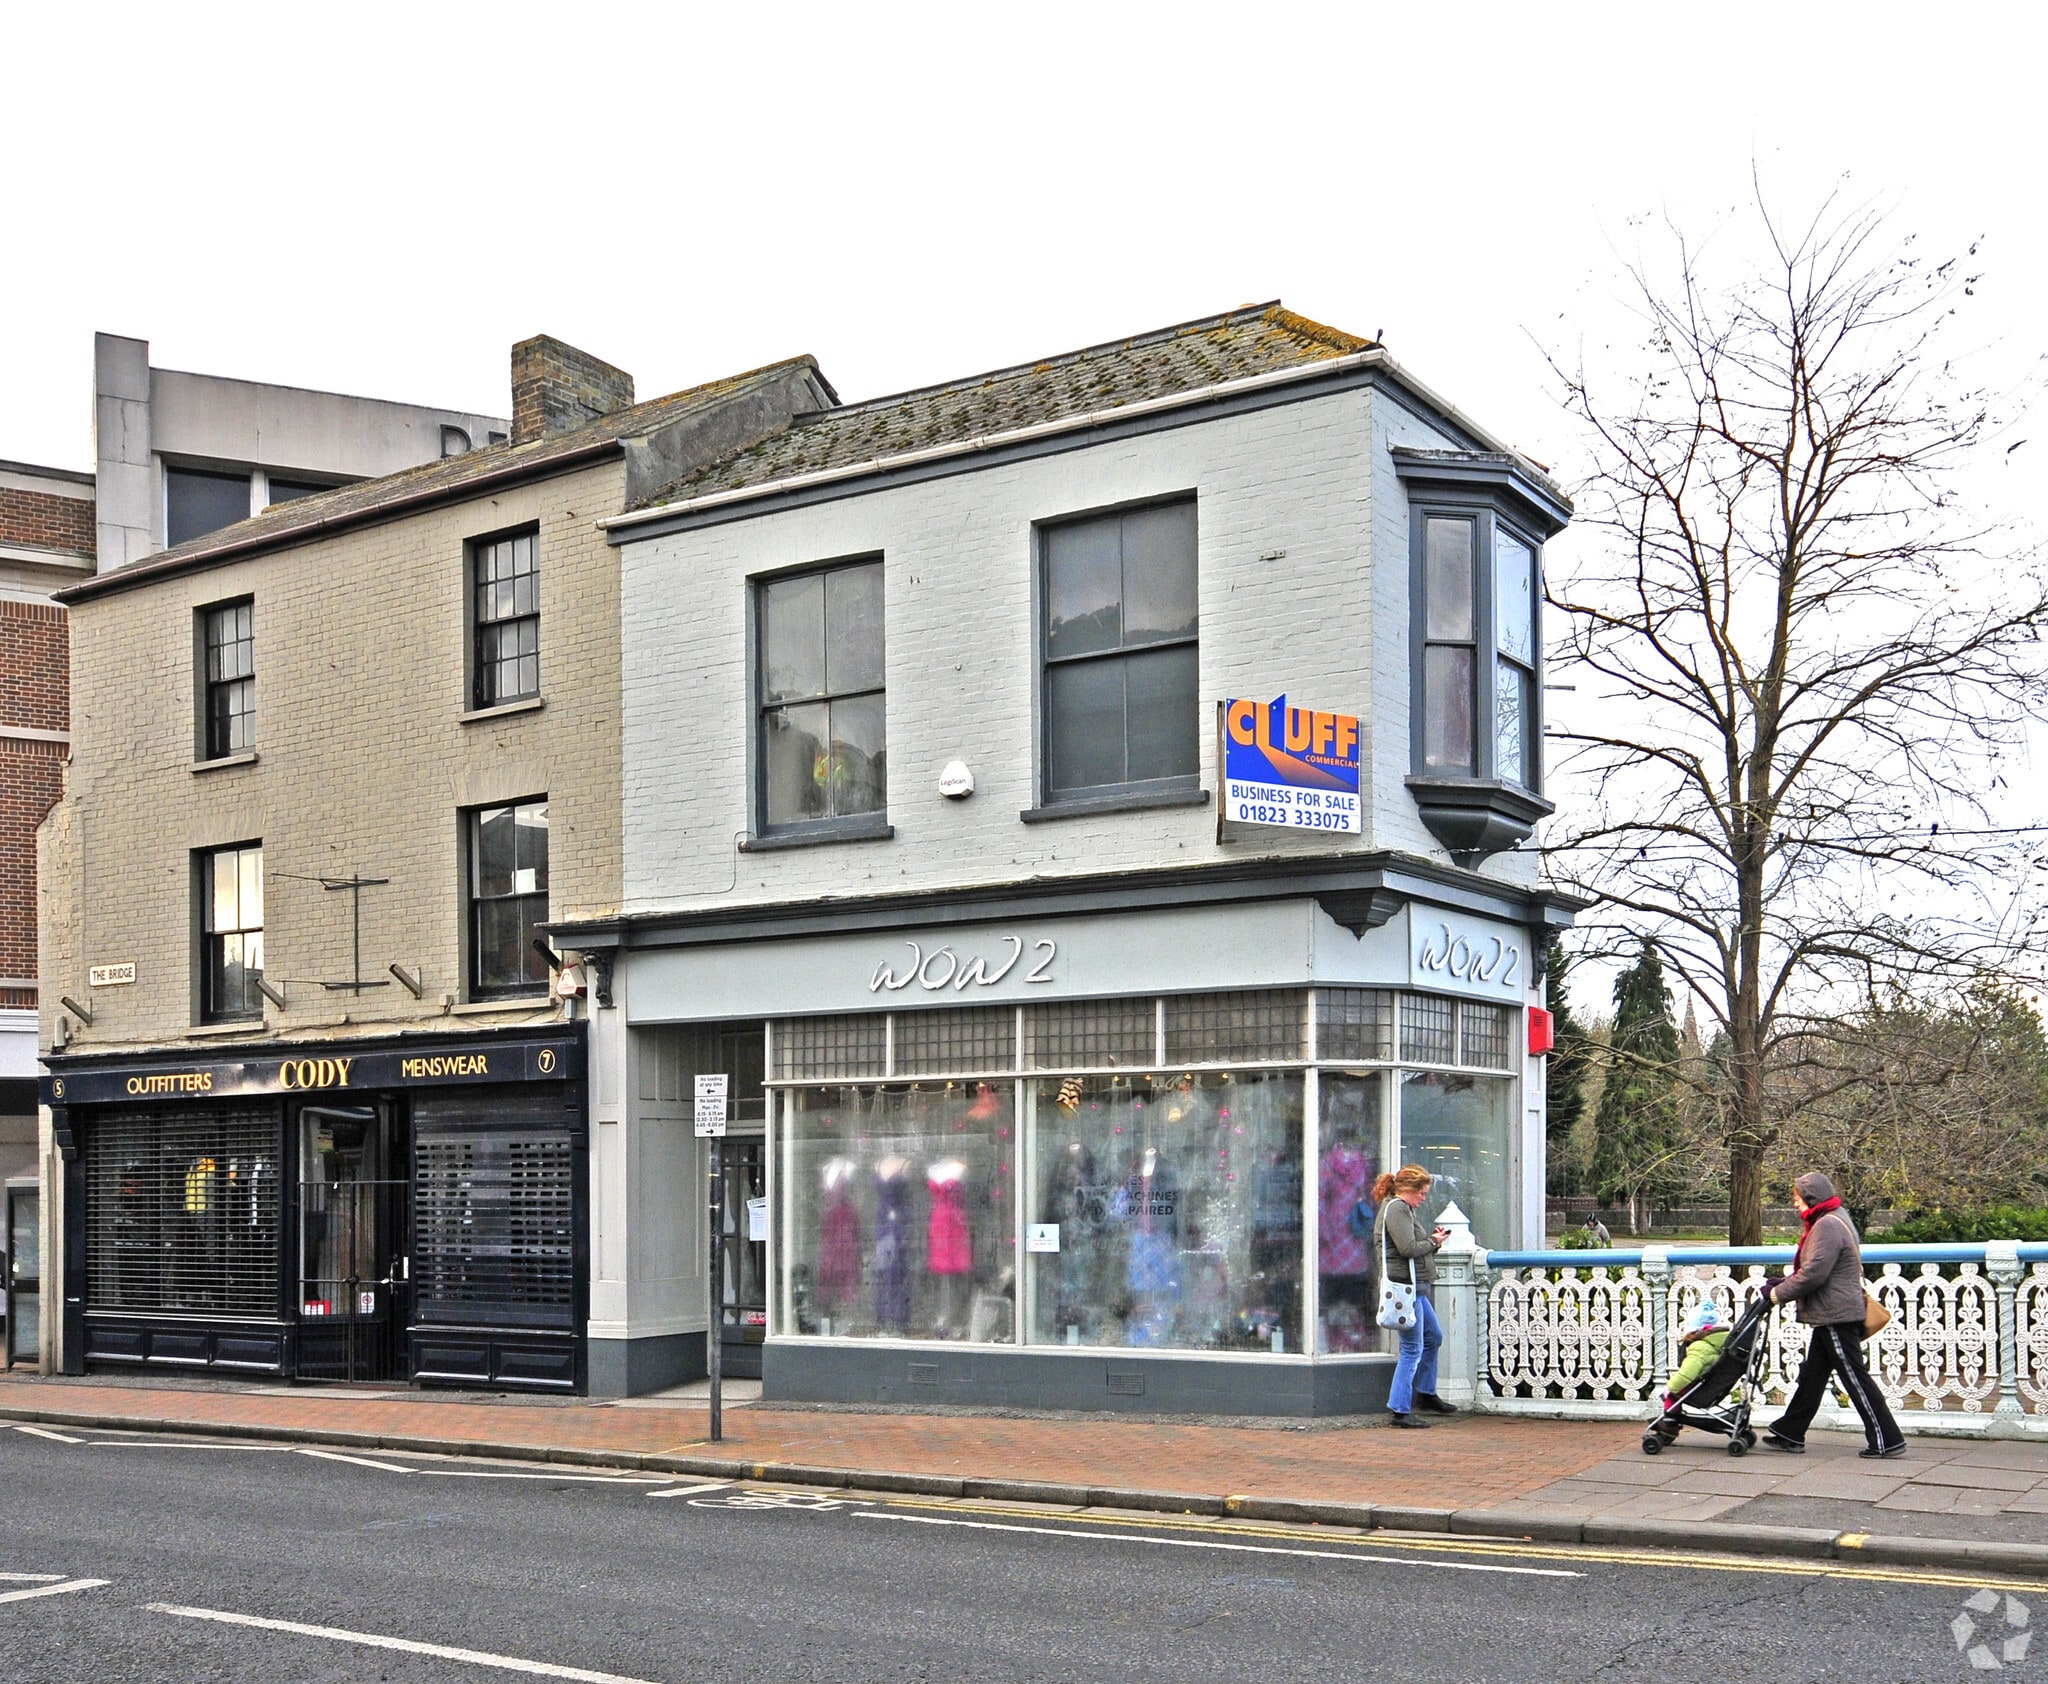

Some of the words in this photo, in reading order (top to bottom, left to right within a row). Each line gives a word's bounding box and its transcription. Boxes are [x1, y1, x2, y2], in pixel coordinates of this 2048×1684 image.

[1227, 698, 1359, 758] CLUFF
[1305, 755, 1358, 769] COMMERCIAL
[1231, 784, 1292, 804] BUSINESS
[1296, 792, 1321, 807] FOR
[1325, 795, 1355, 811] SALE
[1239, 804, 1287, 823] 01823
[1294, 810, 1350, 830] 333075
[92, 969, 106, 981] THE
[108, 966, 133, 980] BRIDGE
[1024, 939, 1057, 983] 2
[1502, 945, 1520, 987] 2
[278, 1058, 352, 1090] CODY
[402, 1055, 488, 1078] MENSWEAR
[126, 1072, 213, 1095] OUTFITTERS
